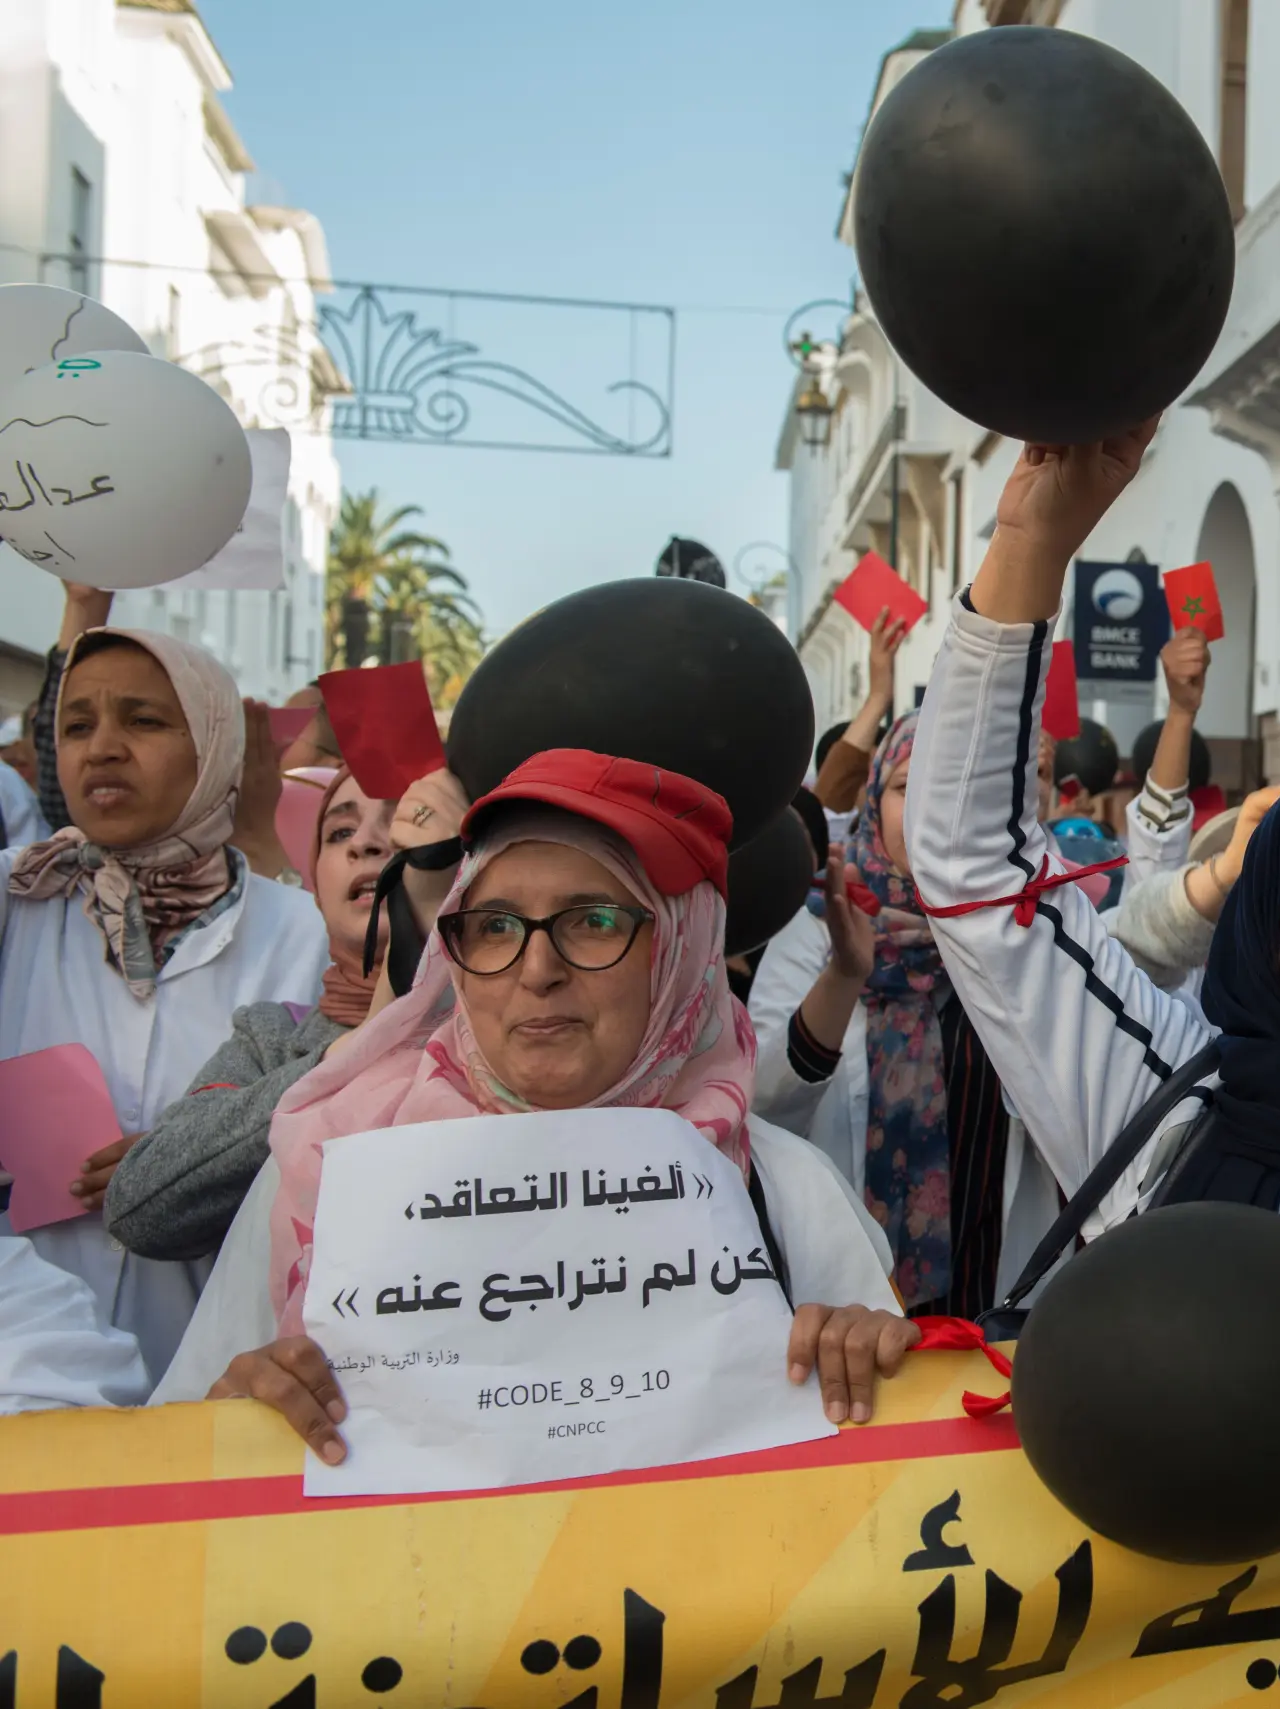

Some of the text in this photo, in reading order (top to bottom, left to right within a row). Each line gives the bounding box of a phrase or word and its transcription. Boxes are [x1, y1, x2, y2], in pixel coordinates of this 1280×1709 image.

[1091, 627, 1141, 643] BMCE
[1091, 652, 1140, 668] BANK
[642, 1248, 697, 1309] لم
[375, 1273, 463, 1316] عنه
[478, 1255, 627, 1323] نتراجع
[381, 1352, 421, 1371] التربية
[426, 1349, 460, 1368] وزارة
[477, 1369, 670, 1410] #CODE_8_9_10
[547, 1420, 606, 1439] #CNPCC
